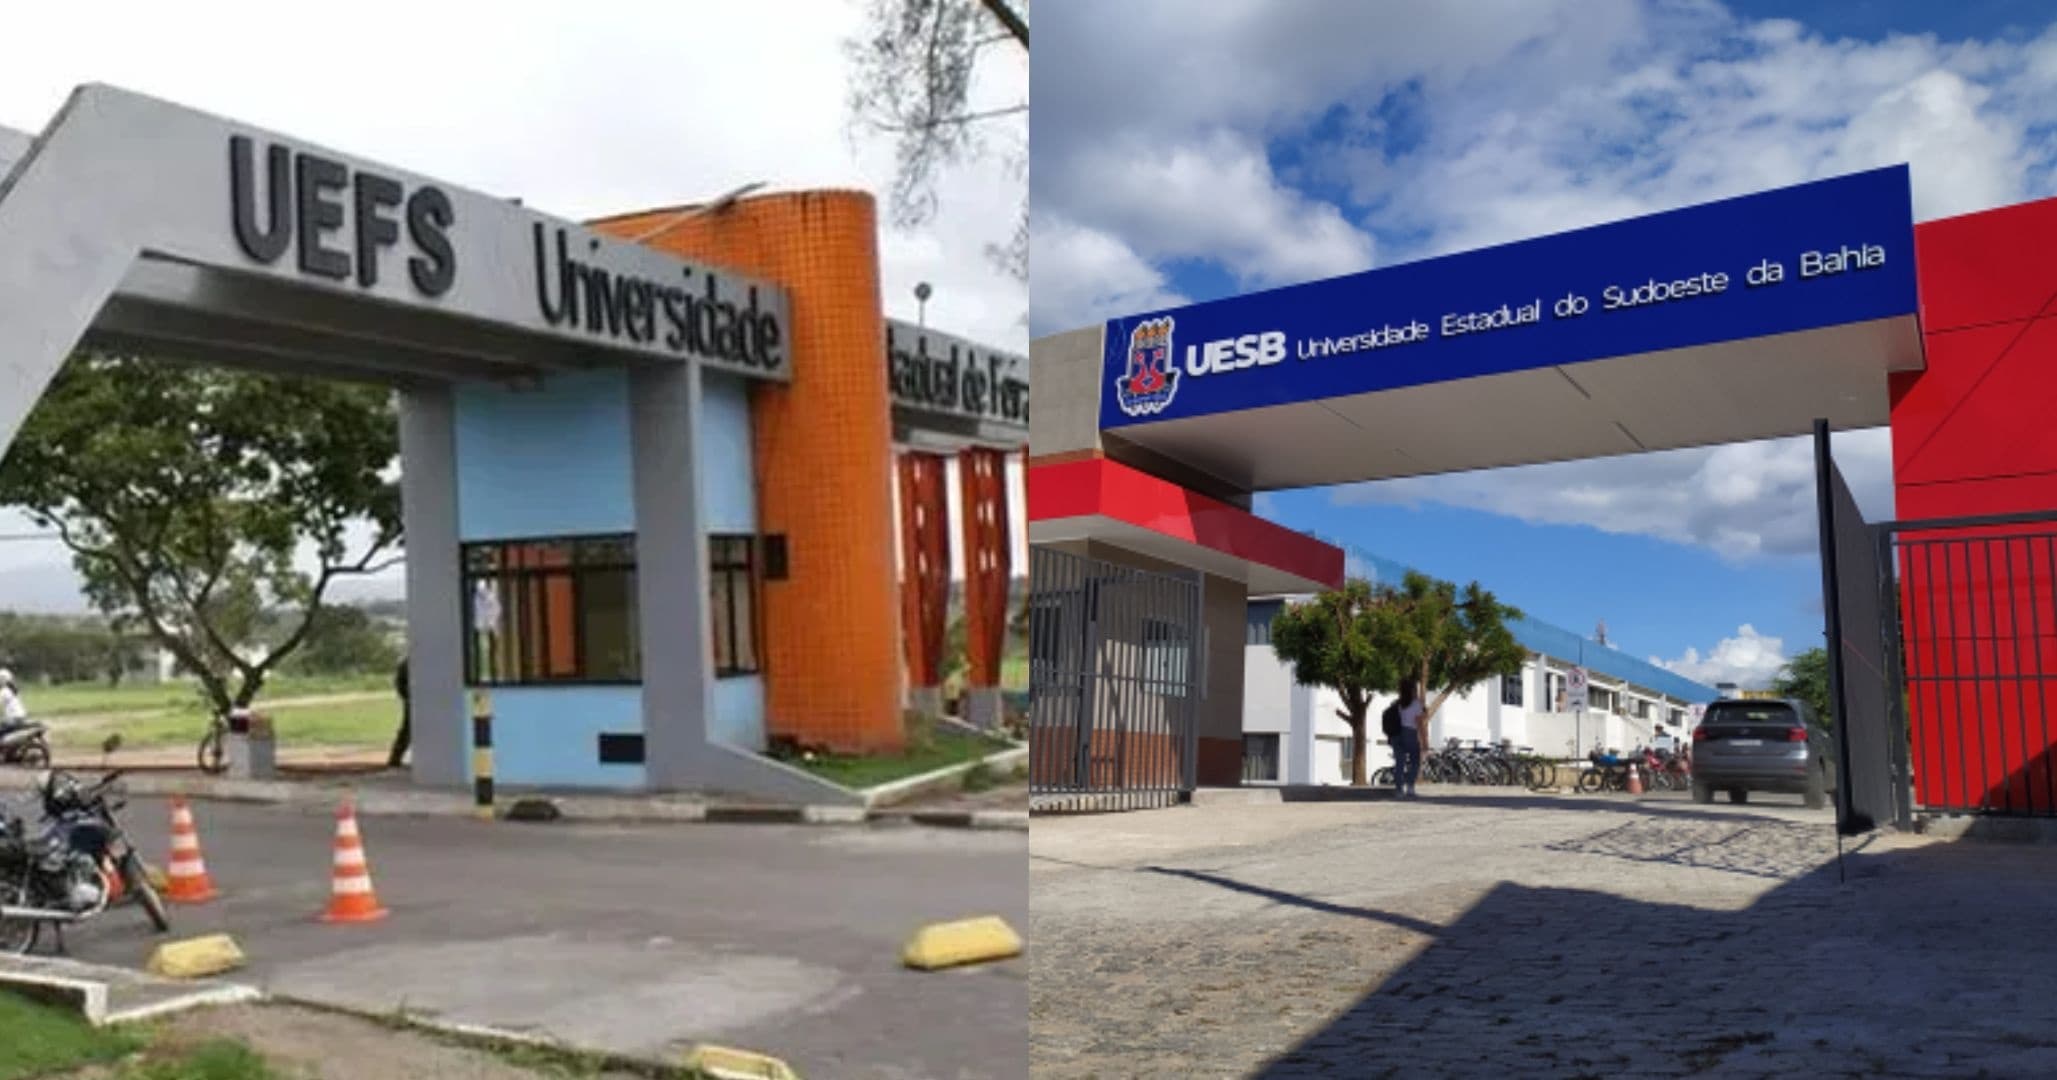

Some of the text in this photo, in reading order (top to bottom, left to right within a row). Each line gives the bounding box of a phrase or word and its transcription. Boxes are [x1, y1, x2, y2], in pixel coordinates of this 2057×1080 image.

[229, 134, 456, 298] UEFS
[533, 222, 781, 369] Universidade
[1186, 330, 1286, 376] UESB
[1297, 243, 1886, 360] Universidade Estadual do Sudoeste da Bahia
